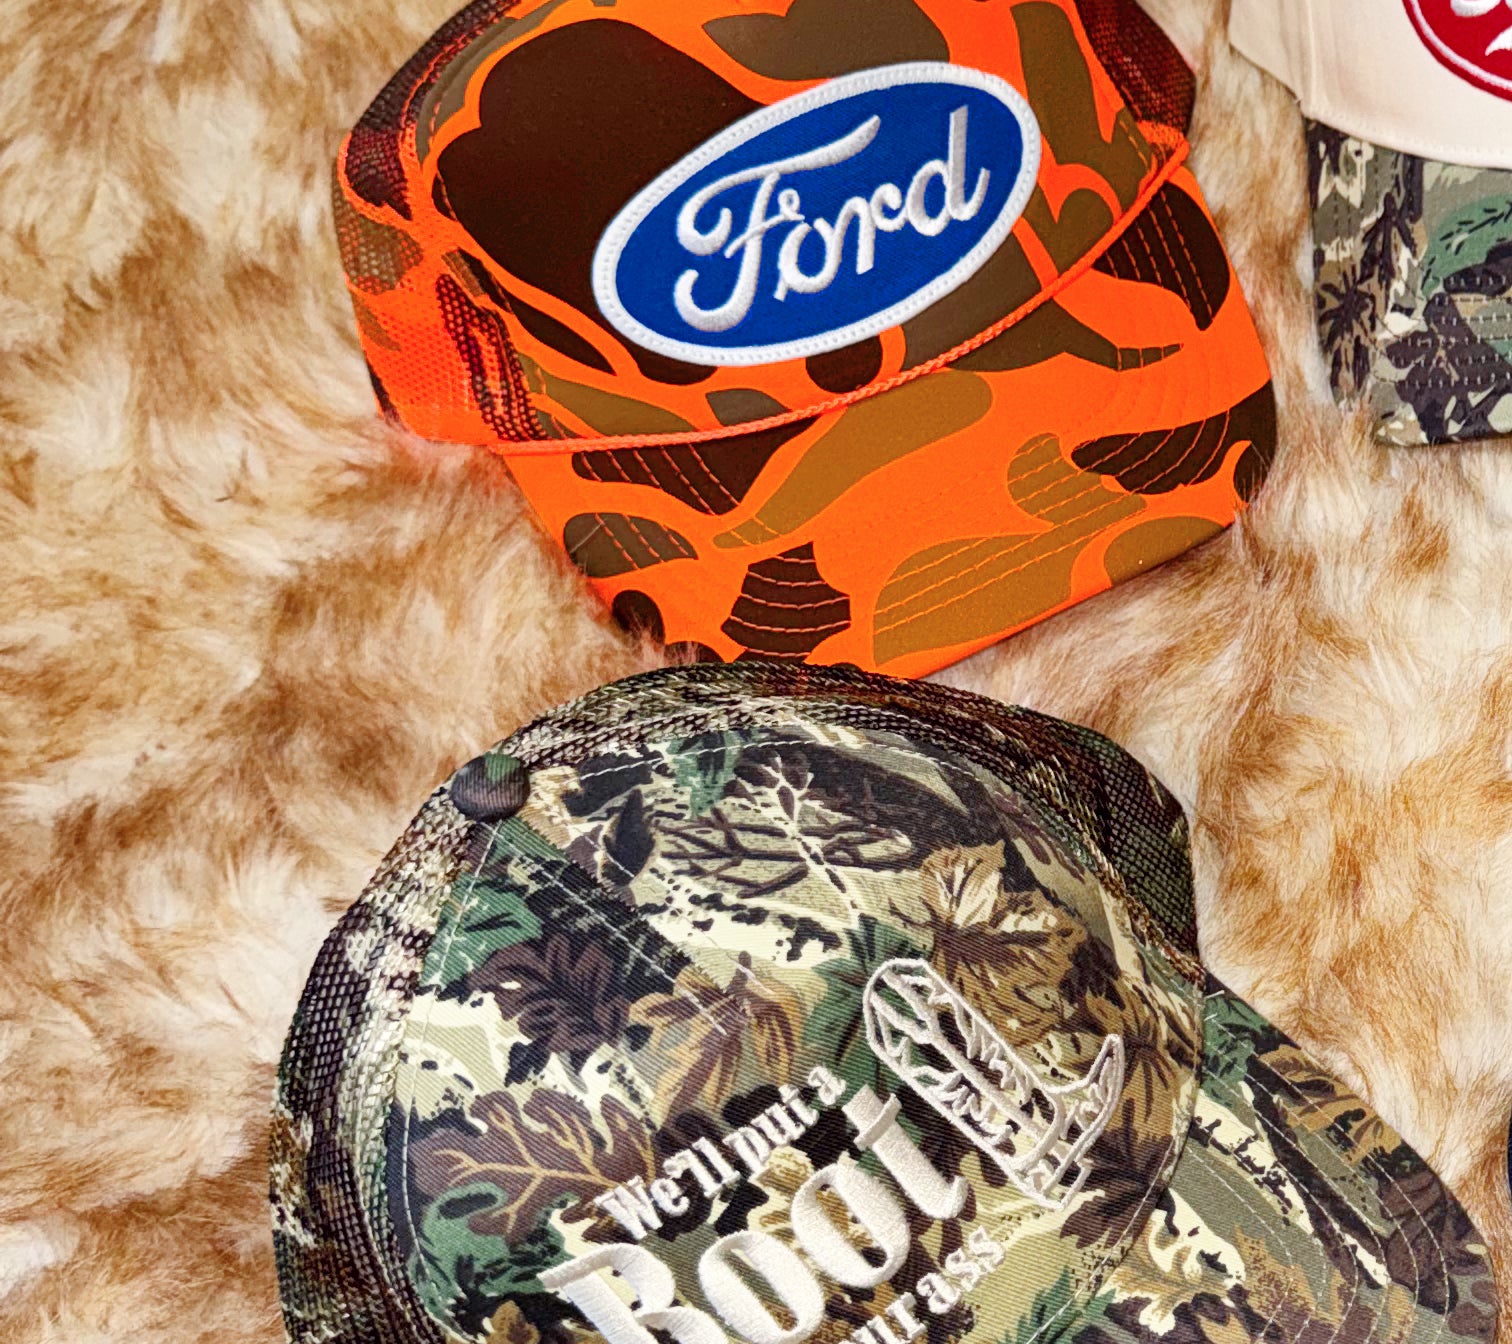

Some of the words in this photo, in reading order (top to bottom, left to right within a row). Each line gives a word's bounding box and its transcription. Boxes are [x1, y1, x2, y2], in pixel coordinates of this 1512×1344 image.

[674, 104, 991, 333] Ford
[596, 1138, 740, 1242] We'll
[722, 1083, 822, 1179] put
[806, 1064, 847, 1106] a
[918, 1224, 1007, 1315] ass
